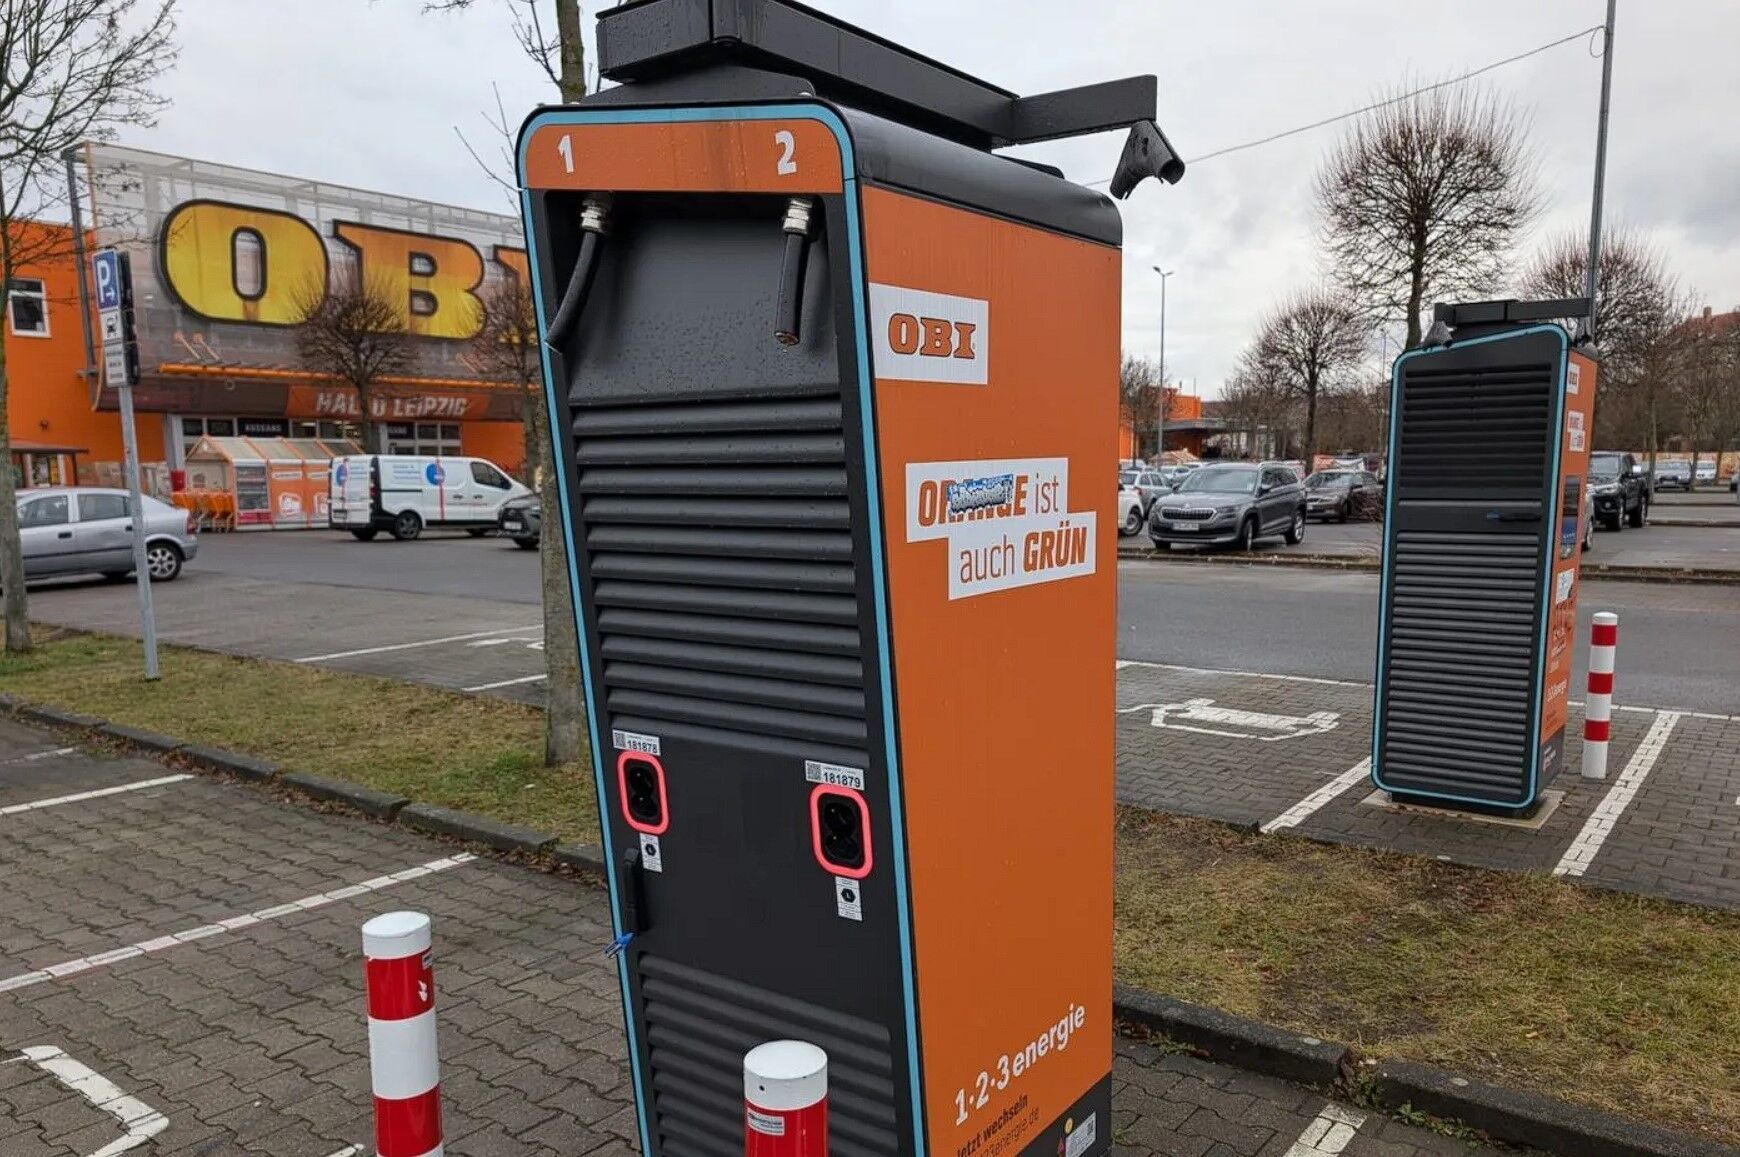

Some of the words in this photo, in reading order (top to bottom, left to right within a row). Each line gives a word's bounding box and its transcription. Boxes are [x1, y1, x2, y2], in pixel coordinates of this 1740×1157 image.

[558, 134, 574, 173] 1
[775, 130, 797, 175] 2
[97, 259, 111, 303] P
[888, 312, 976, 359] OBI
[1035, 473, 1060, 514] ist
[960, 534, 1015, 584] auch
[1023, 520, 1088, 573] GRÜN
[627, 739, 658, 754] 181878
[824, 772, 861, 788] 181879
[983, 1094, 1028, 1142] wechseln
